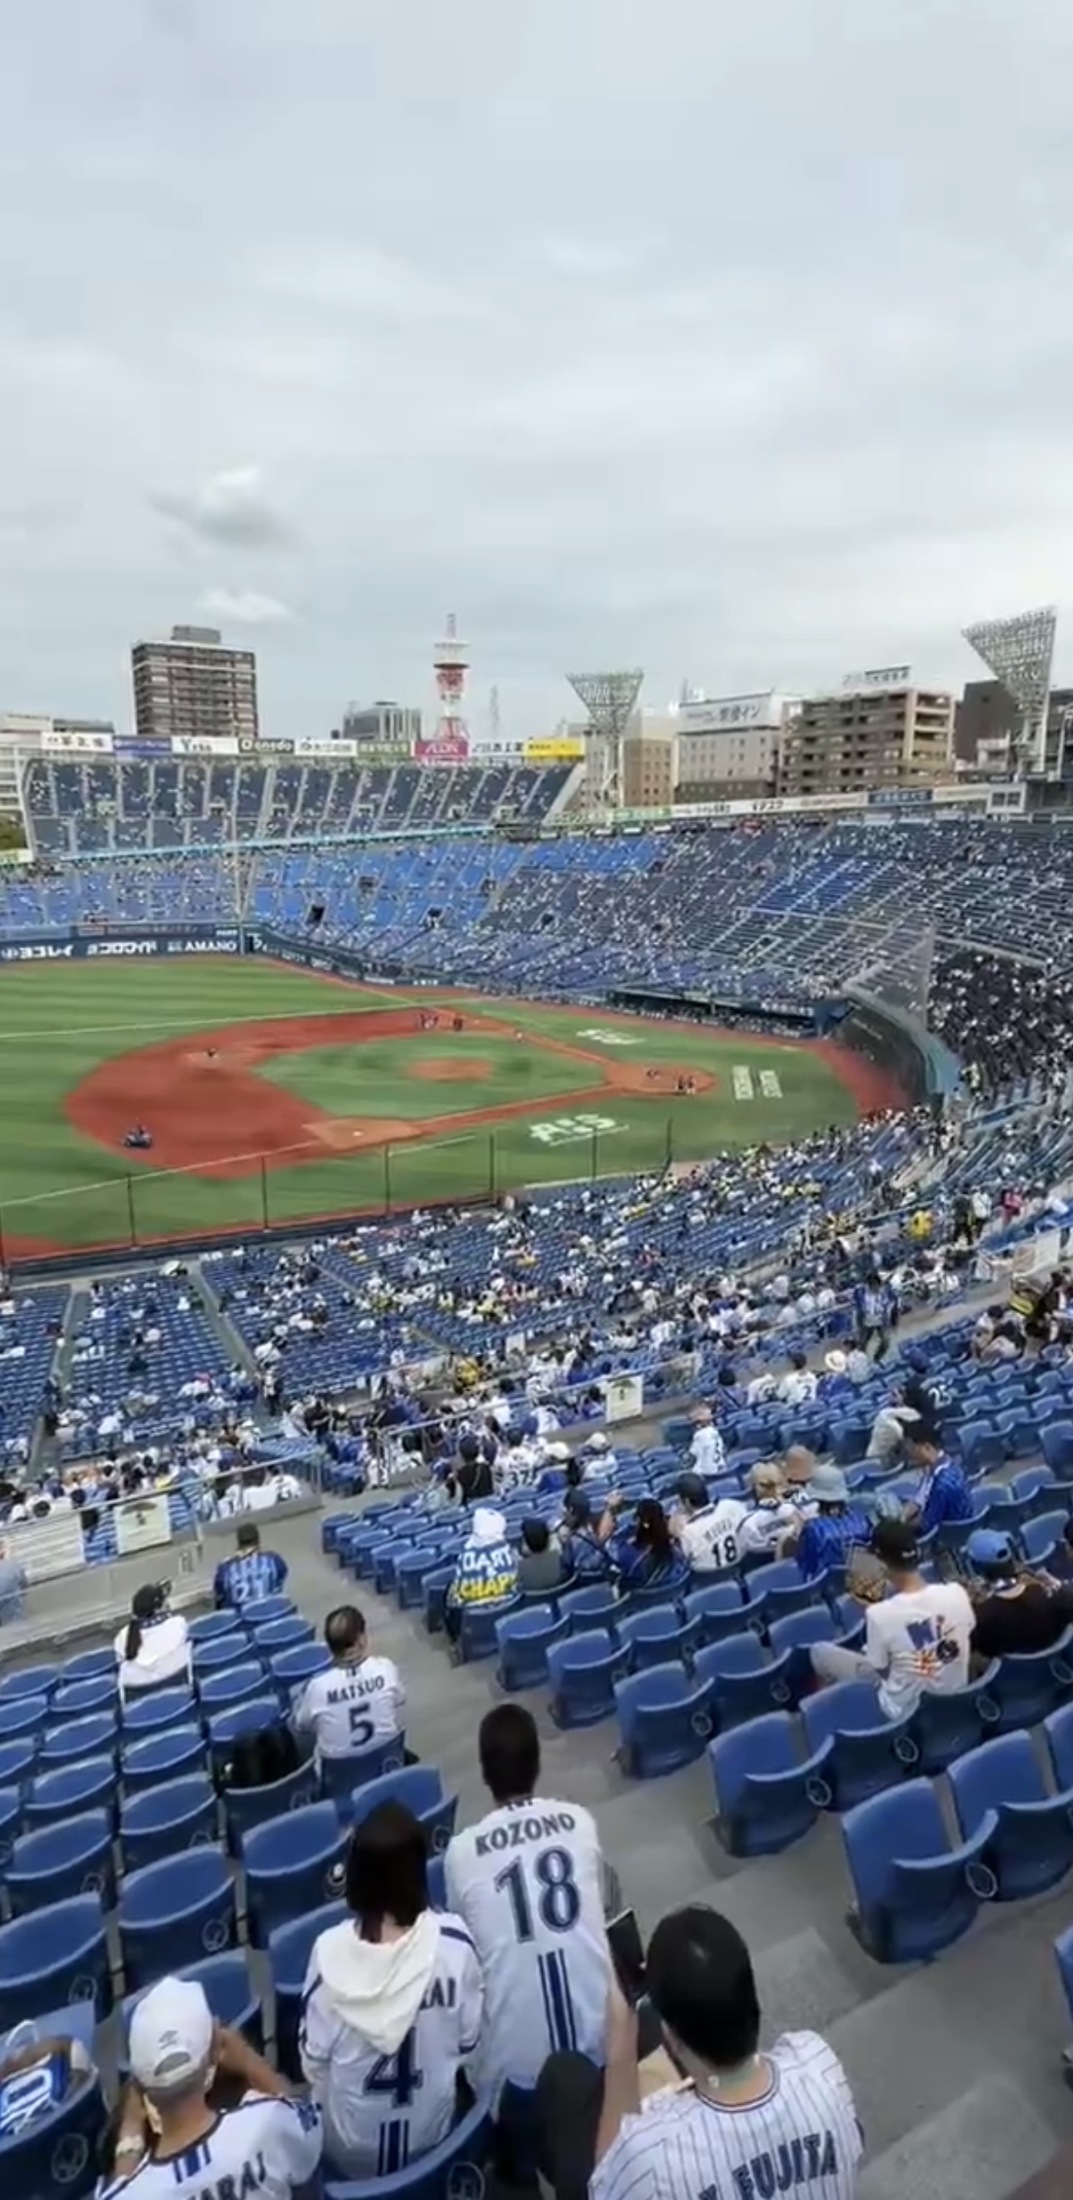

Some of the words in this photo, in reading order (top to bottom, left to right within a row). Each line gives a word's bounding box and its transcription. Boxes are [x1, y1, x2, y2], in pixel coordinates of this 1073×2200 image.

[185, 941, 237, 951] AMANO
[711, 1534, 737, 1567] 18
[326, 1674, 385, 1704] MATSUO
[348, 1701, 375, 1748] 5
[475, 1813, 576, 1857] KOZONO
[493, 1844, 581, 1944] 18
[362, 2025, 424, 2110] 4
[732, 2130, 838, 2200] FUJITA
